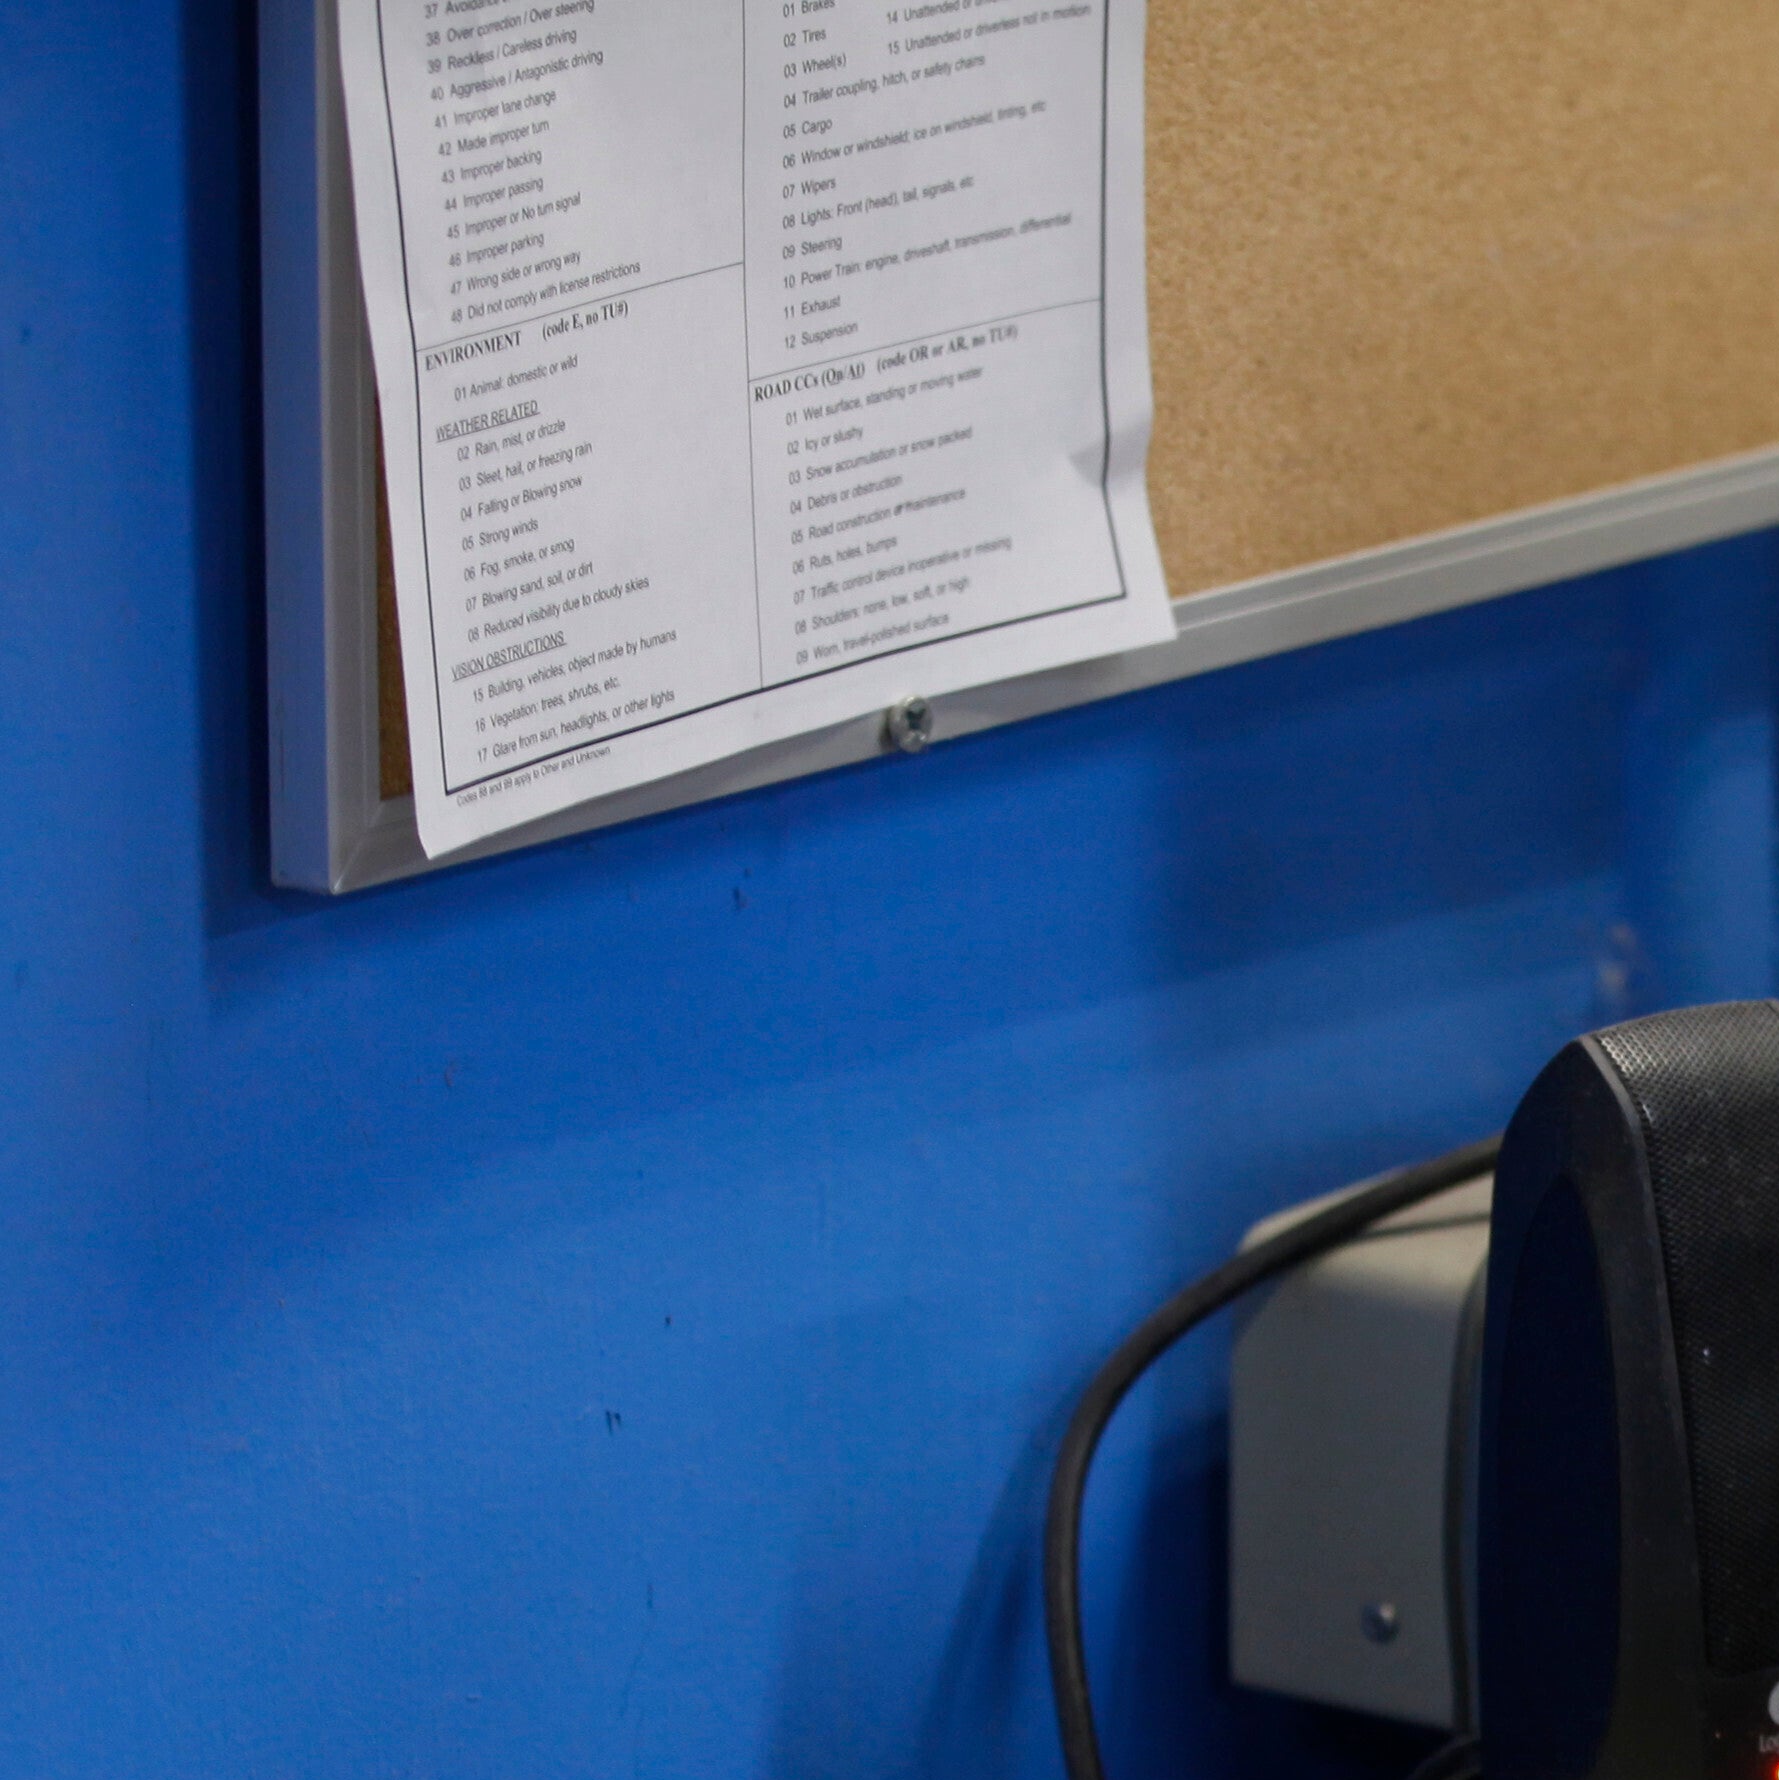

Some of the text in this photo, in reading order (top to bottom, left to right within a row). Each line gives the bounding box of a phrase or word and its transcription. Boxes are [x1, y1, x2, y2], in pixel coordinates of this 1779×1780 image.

[424, 4, 439, 19] 37
[801, 0, 835, 14] Brakes
[426, 0, 595, 47] 38 Over correction Over steering
[803, 29, 827, 43] Tires
[427, 30, 577, 74] 39 Reckless Careless driving
[905, 29, 962, 51] Unattended
[430, 51, 603, 100] 40 Aggressive Antagonistic driving
[802, 54, 846, 73] Wheel(s)
[434, 91, 557, 128] 41 Improper lane change
[803, 88, 834, 104] Trailer
[438, 121, 549, 156] 42 Made improper turn
[801, 119, 833, 134] Cargo
[441, 151, 542, 183] 43 Improper backing
[801, 148, 841, 164] Window
[444, 178, 544, 212] 44 Improper passing
[800, 179, 836, 195] Wipers
[446, 225, 460, 239] 45
[465, 216, 507, 235] Improper
[521, 206, 535, 220] No
[536, 203, 554, 217] turn
[555, 193, 581, 211] signal
[448, 234, 545, 267] 46 Improper parking
[800, 237, 842, 255] Steering
[450, 281, 462, 295] 47
[466, 274, 499, 290] Wrong
[500, 267, 521, 283] side
[534, 257, 562, 273] wrong
[563, 252, 581, 265] way
[800, 269, 832, 285] Power
[450, 263, 641, 323] 48 Did not comply with license restrictions
[800, 296, 841, 316] Exhaust
[425, 333, 520, 370] ENVIRONMENT
[542, 320, 570, 339] (code
[585, 313, 599, 325] no
[801, 323, 858, 345] Suspension
[454, 355, 578, 402] 01 domestic wild
[754, 380, 792, 401] ROAD
[435, 401, 538, 441] WEATHER RELATED
[802, 406, 823, 421] Wet
[456, 446, 470, 462] 02
[537, 421, 566, 439] drizzle
[804, 438, 819, 451] Icy
[458, 443, 592, 492] 03 freezing rain
[805, 465, 834, 480] Snow
[460, 476, 582, 522] 04 Falling Blowing snow
[807, 492, 839, 510] Debris
[461, 519, 539, 551] 05 Strong winds
[807, 522, 834, 539] Road
[463, 539, 575, 582] 06 smog
[465, 562, 594, 612] 07 Blowing dirt
[810, 582, 841, 599] Traffic
[467, 578, 649, 643] 08 Reduced visibility due cloudy skies
[451, 633, 564, 679] VISION OBSTRUCTIONS
[473, 631, 677, 702] 15 object made humans
[475, 718, 486, 733] 16
[477, 691, 675, 763] 17 Glare from other lights
